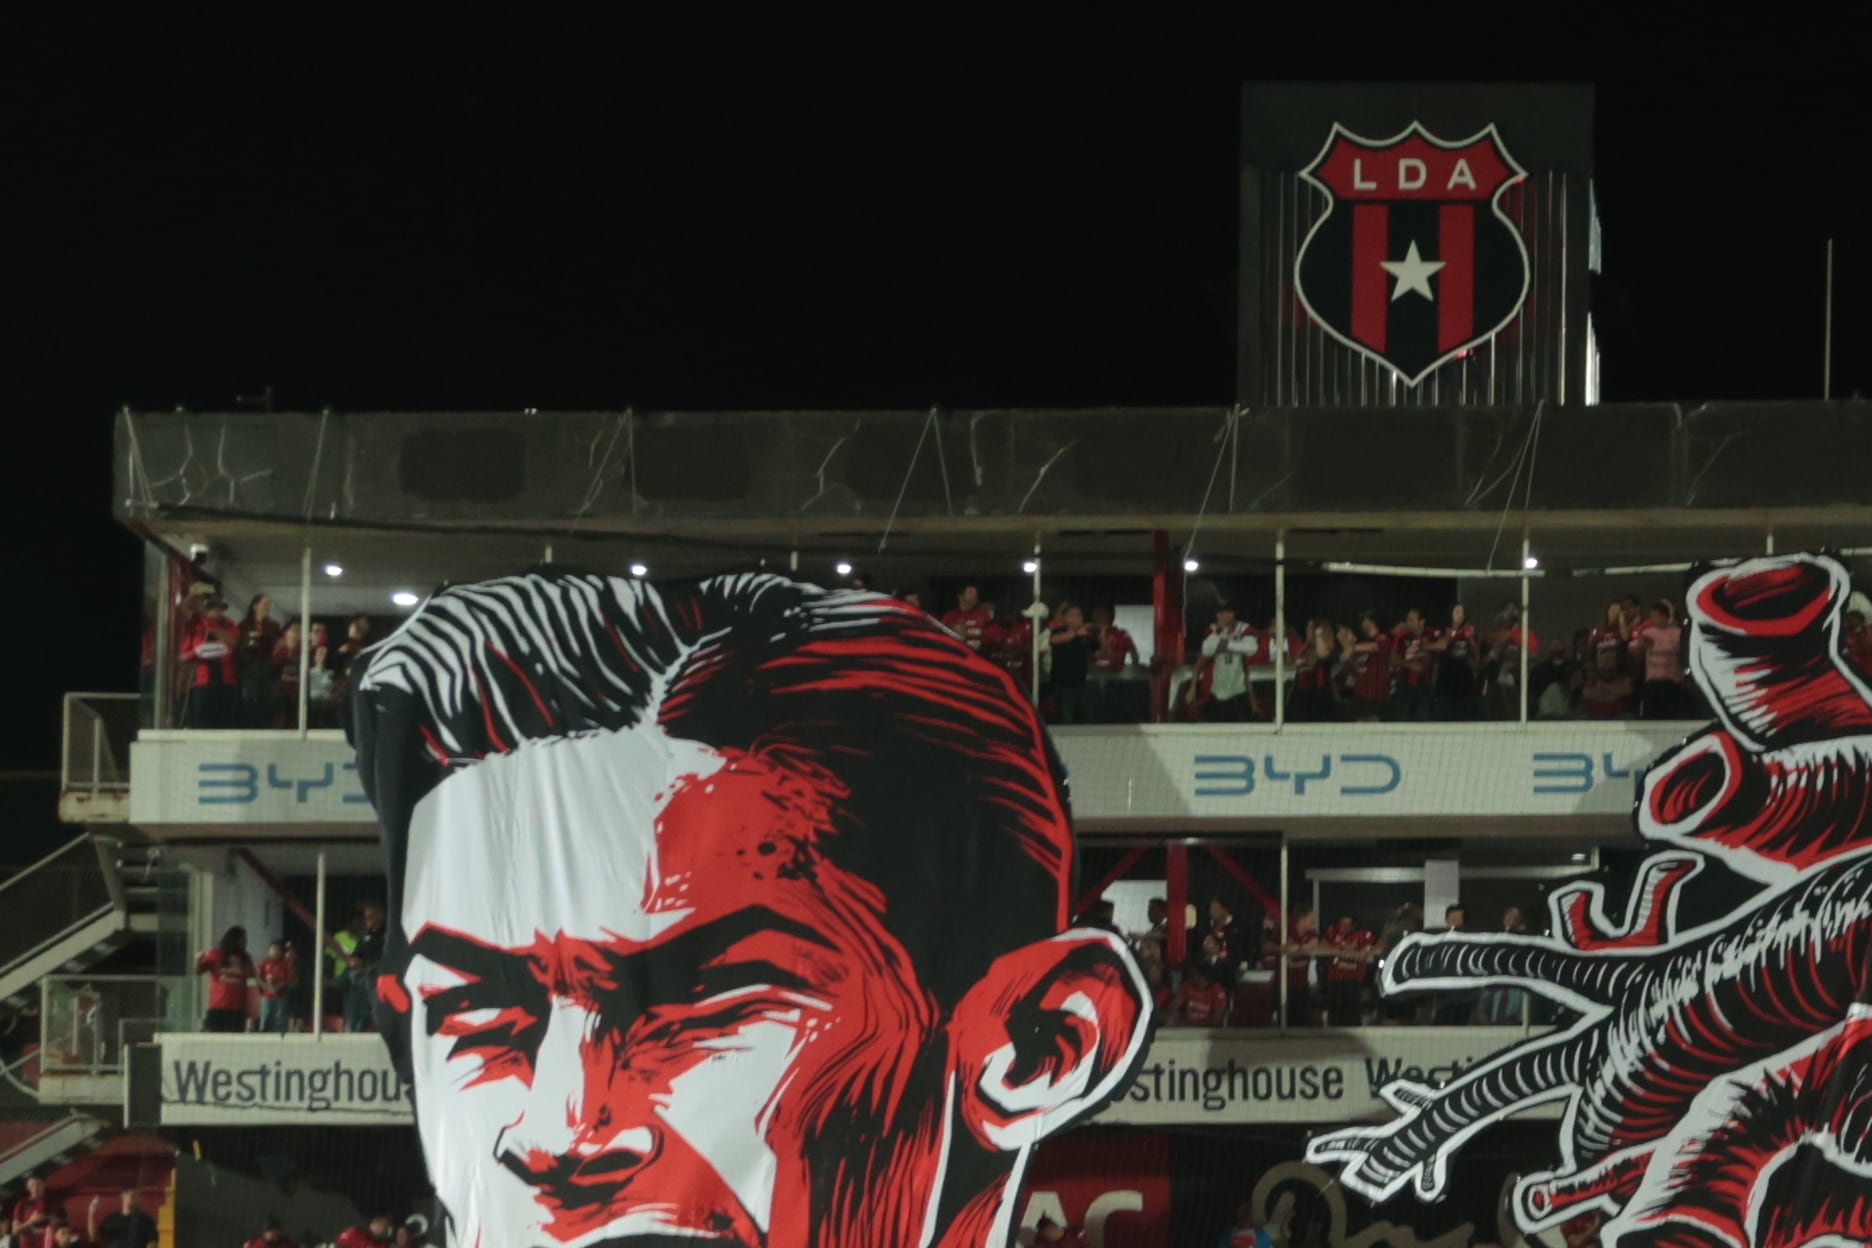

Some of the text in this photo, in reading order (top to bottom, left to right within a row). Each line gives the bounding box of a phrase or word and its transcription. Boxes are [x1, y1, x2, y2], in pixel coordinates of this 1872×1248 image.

[1353, 158, 1477, 190] LDA
[1194, 754, 1401, 796] BYD
[174, 1059, 402, 1112] Westinghou
[1110, 1058, 1345, 1111] stinghouse
